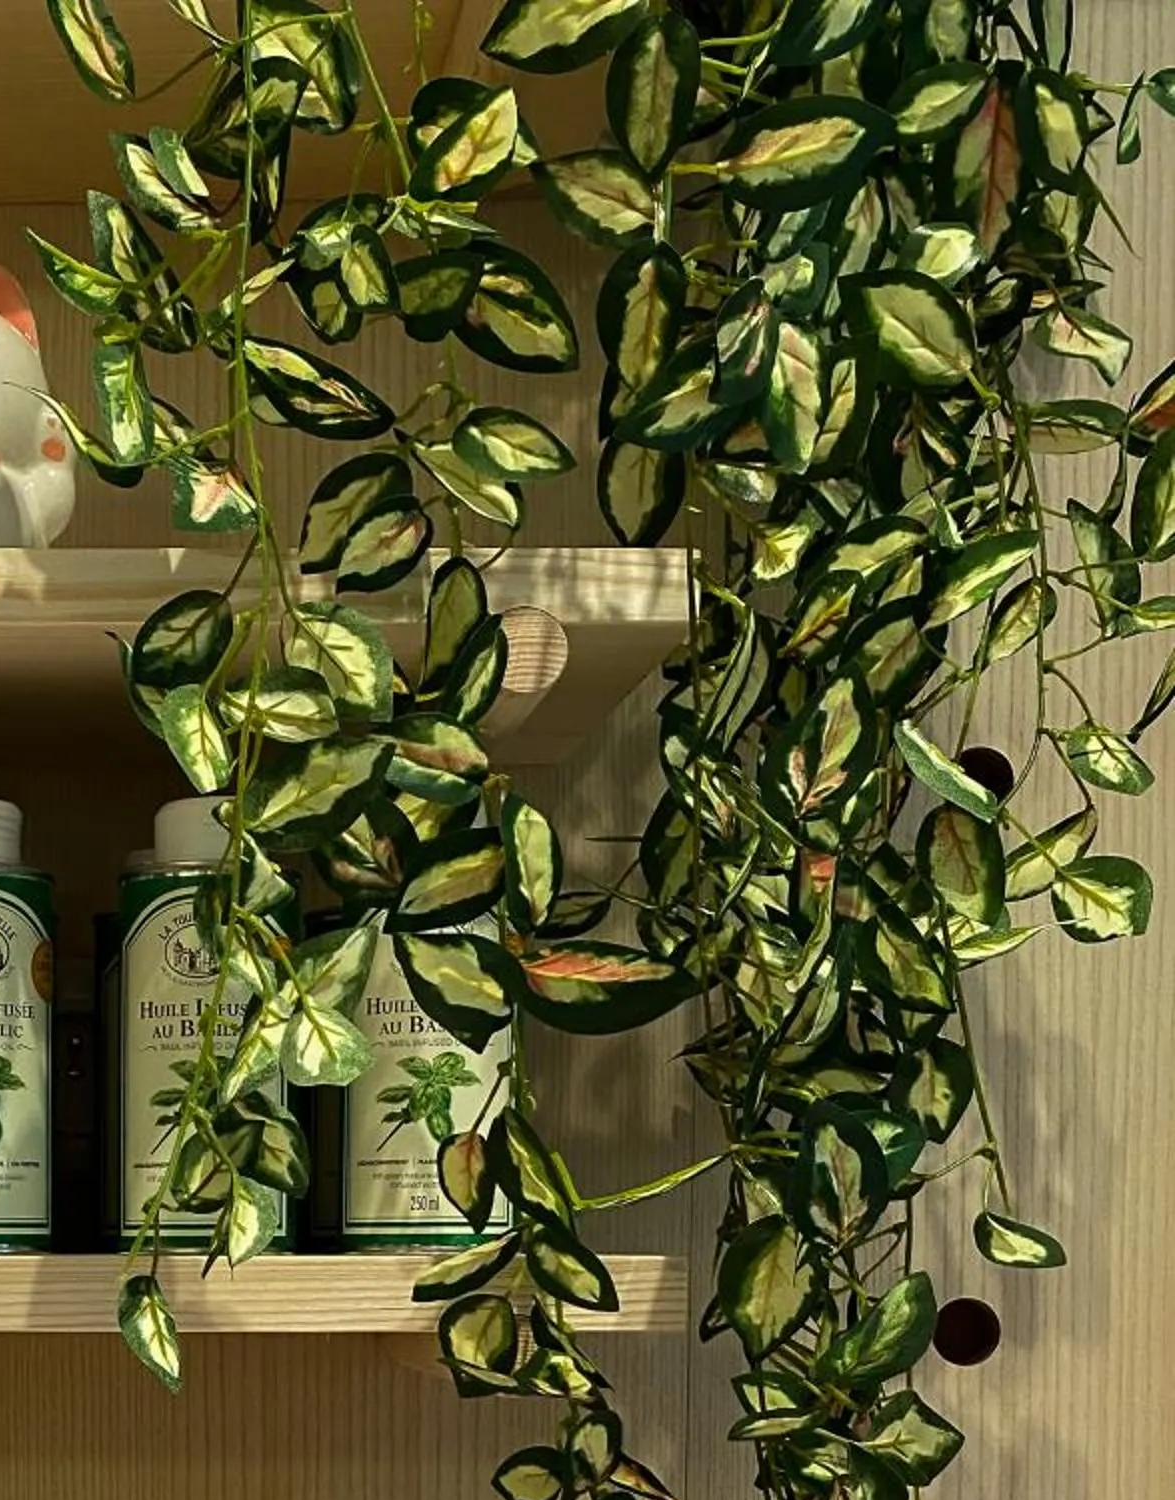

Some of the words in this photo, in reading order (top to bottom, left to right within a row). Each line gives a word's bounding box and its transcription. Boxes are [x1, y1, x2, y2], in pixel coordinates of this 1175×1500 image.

[140, 1001, 190, 1019] HUILE
[152, 1024, 174, 1039] AU
[380, 1021, 402, 1035] AU
